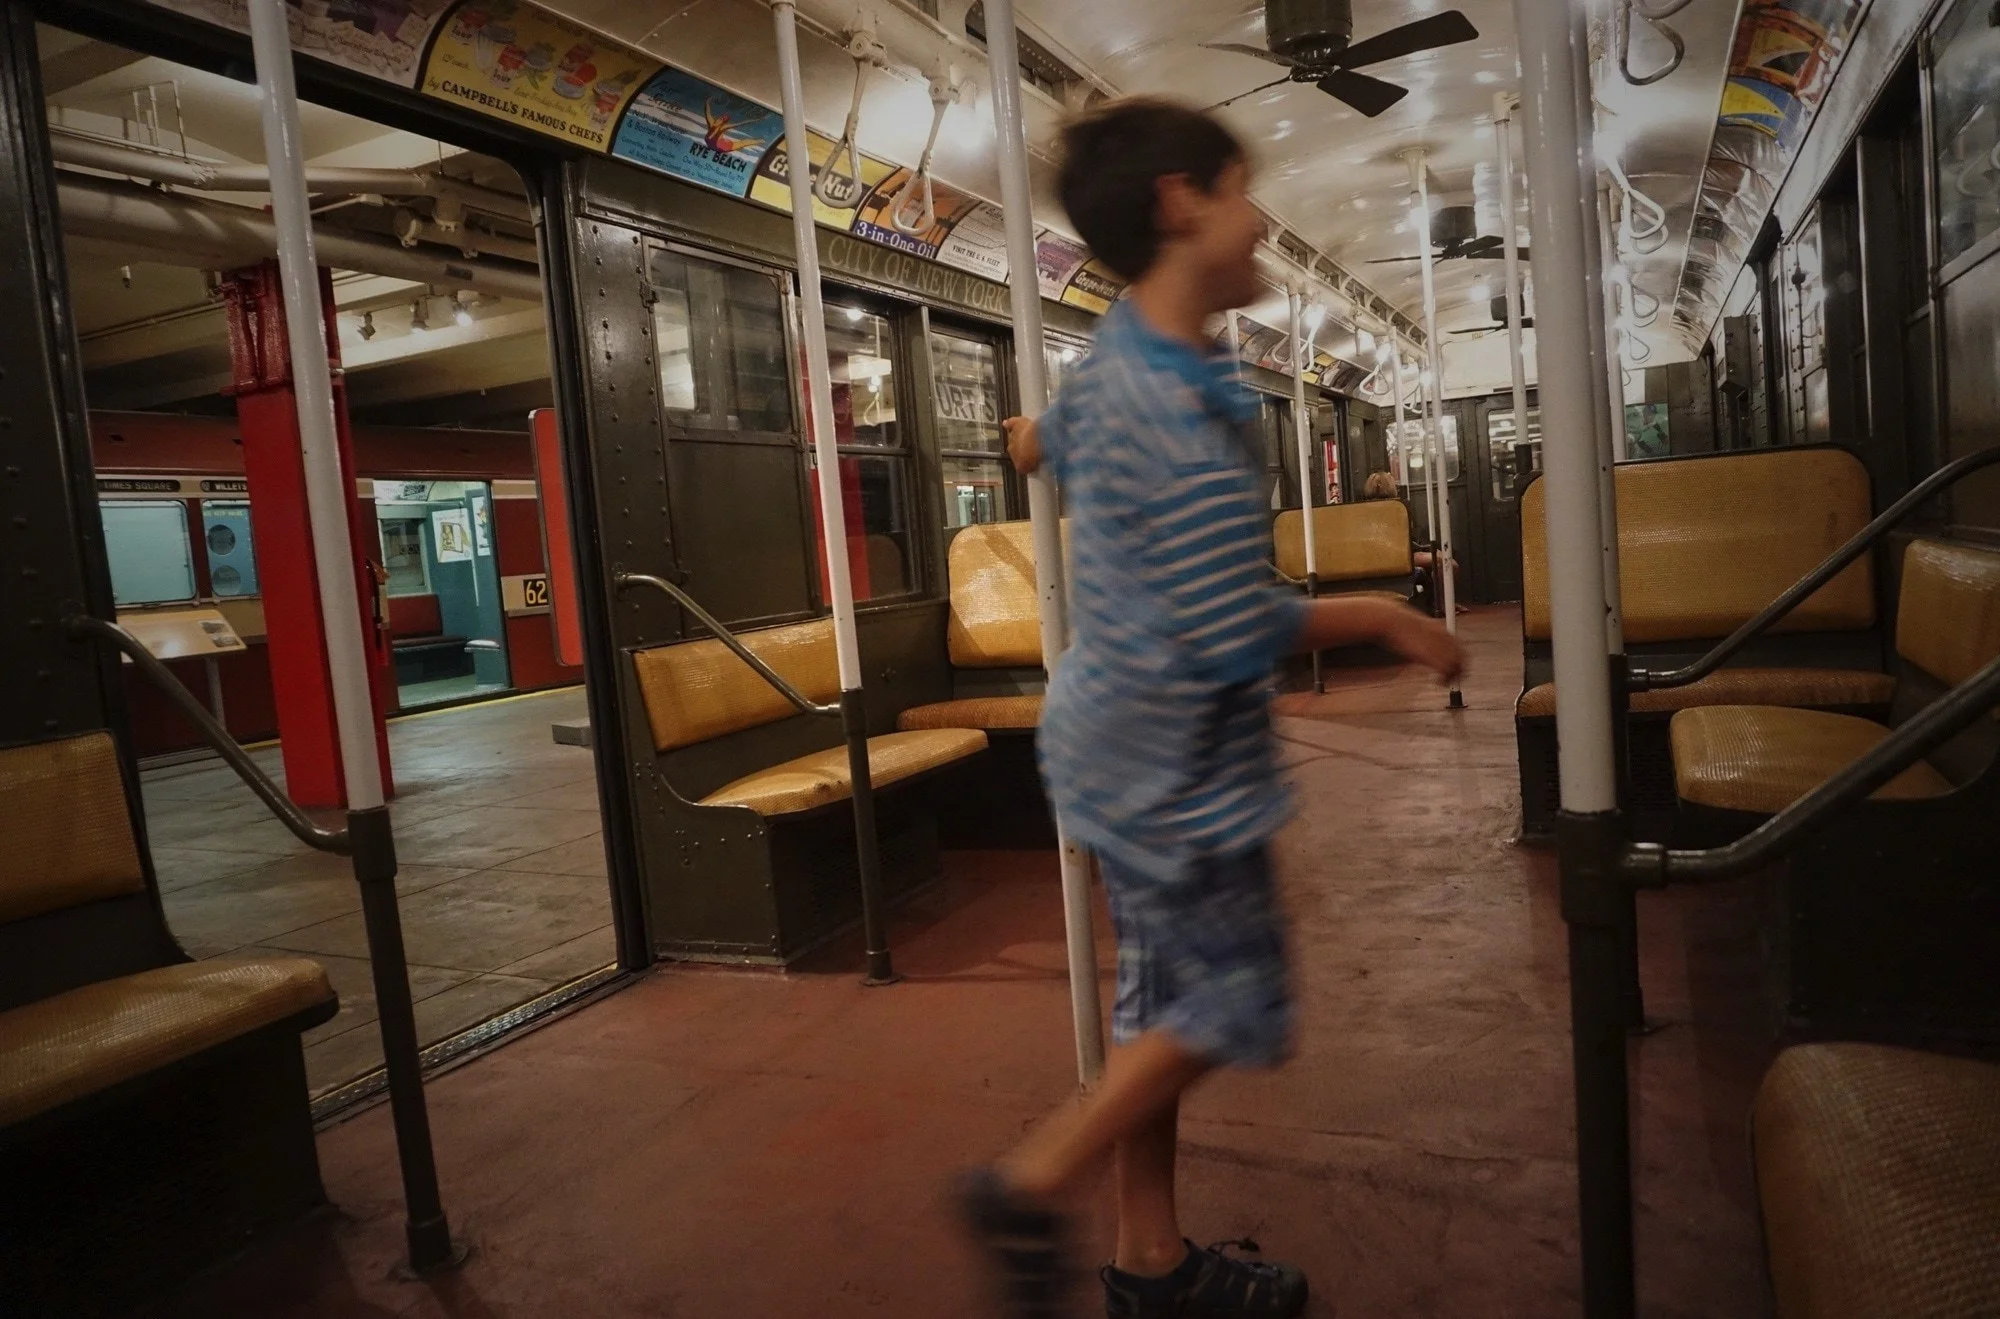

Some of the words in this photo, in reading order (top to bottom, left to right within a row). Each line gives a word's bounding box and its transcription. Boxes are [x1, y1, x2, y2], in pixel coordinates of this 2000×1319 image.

[441, 79, 519, 115] CAMPBELL'S
[521, 107, 567, 132] FAMOUS
[569, 123, 604, 144] CHEFS
[690, 141, 709, 160] RYE
[712, 151, 748, 173] BEACH
[917, 244, 937, 260] Oil
[828, 235, 881, 275] CITY
[885, 253, 914, 284] OF
[915, 264, 960, 299] NEW
[963, 274, 1007, 313] YORK
[103, 481, 132, 491] TIMES
[135, 481, 172, 491] SQUARE
[214, 482, 248, 491] WILLETS
[526, 580, 548, 605] 62
